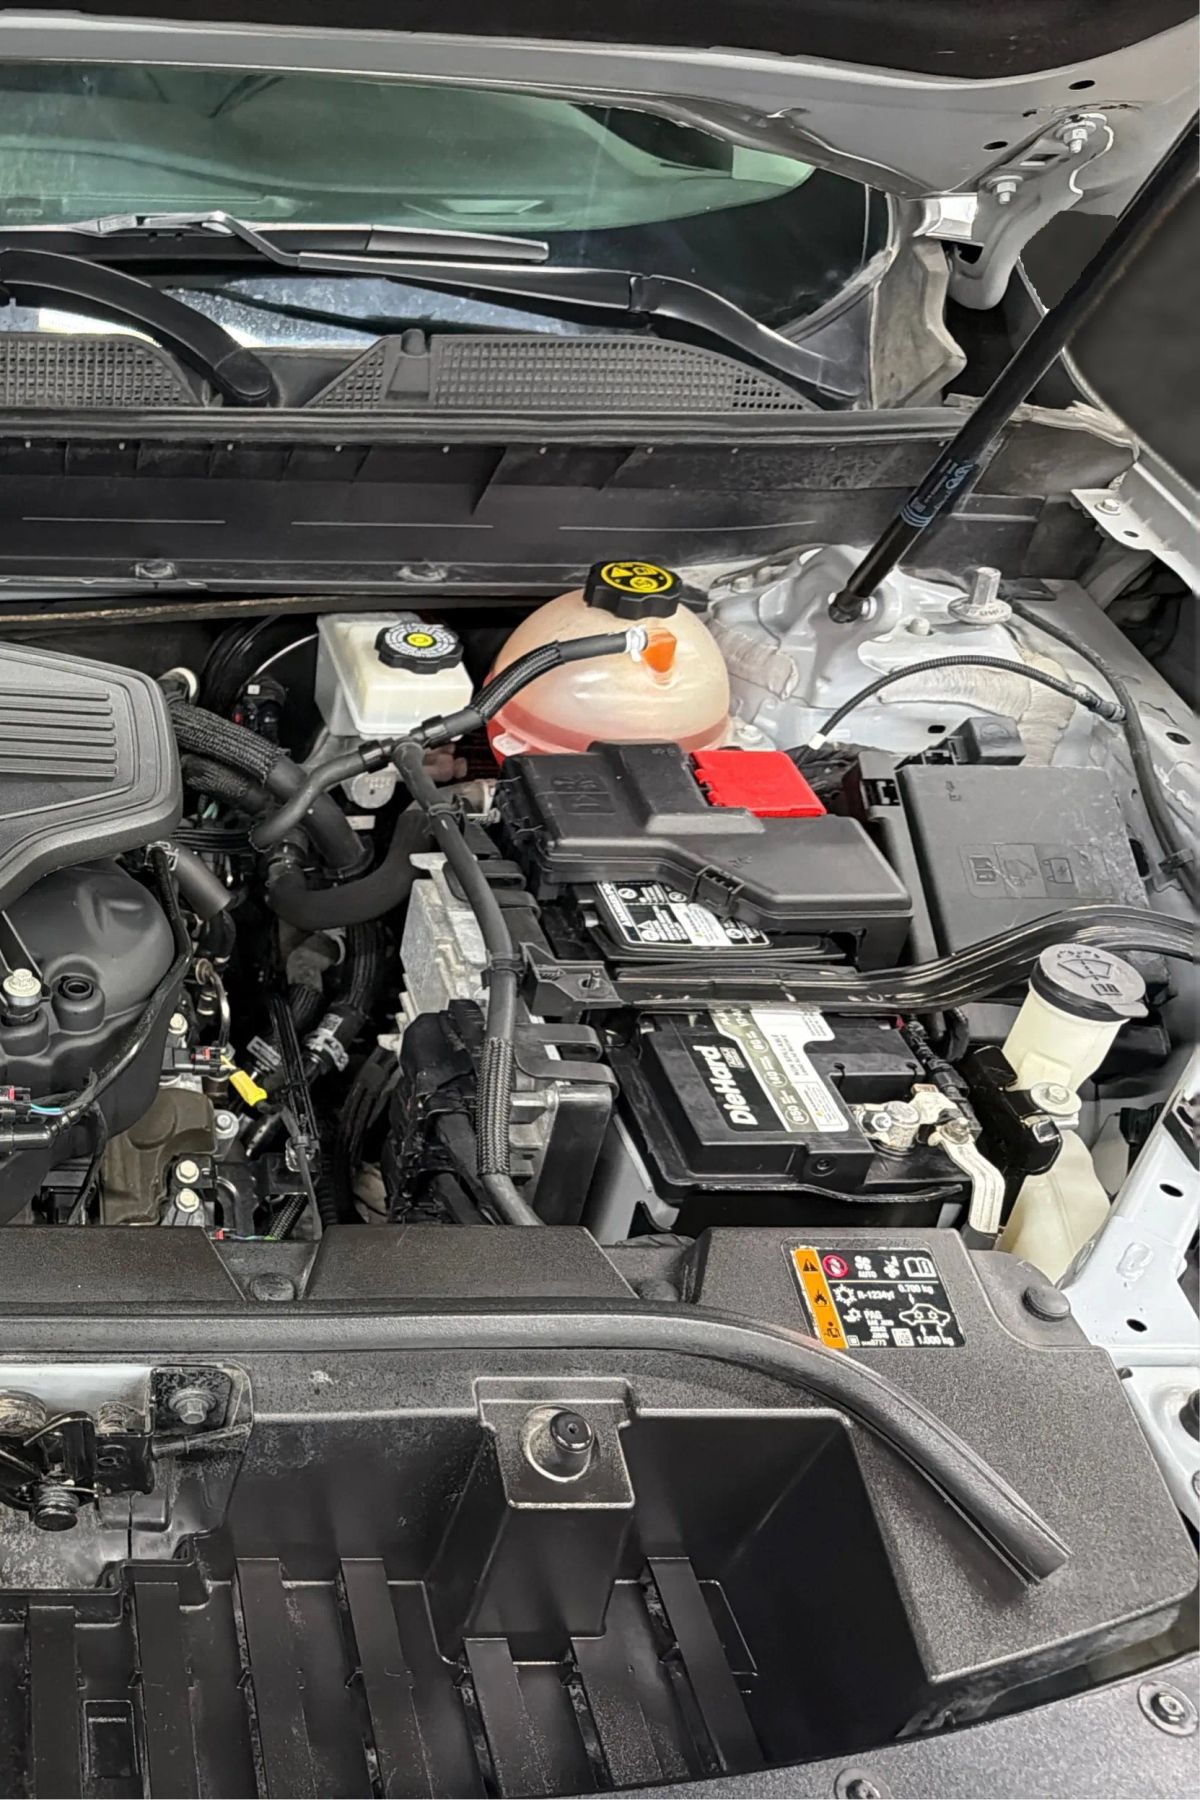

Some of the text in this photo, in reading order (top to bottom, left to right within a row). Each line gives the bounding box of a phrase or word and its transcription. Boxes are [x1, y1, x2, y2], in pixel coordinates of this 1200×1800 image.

[692, 1045, 759, 1126] DieHard
[857, 1271, 878, 1279] AUTO
[921, 1284, 935, 1295] kg
[942, 1336, 955, 1347] kg
